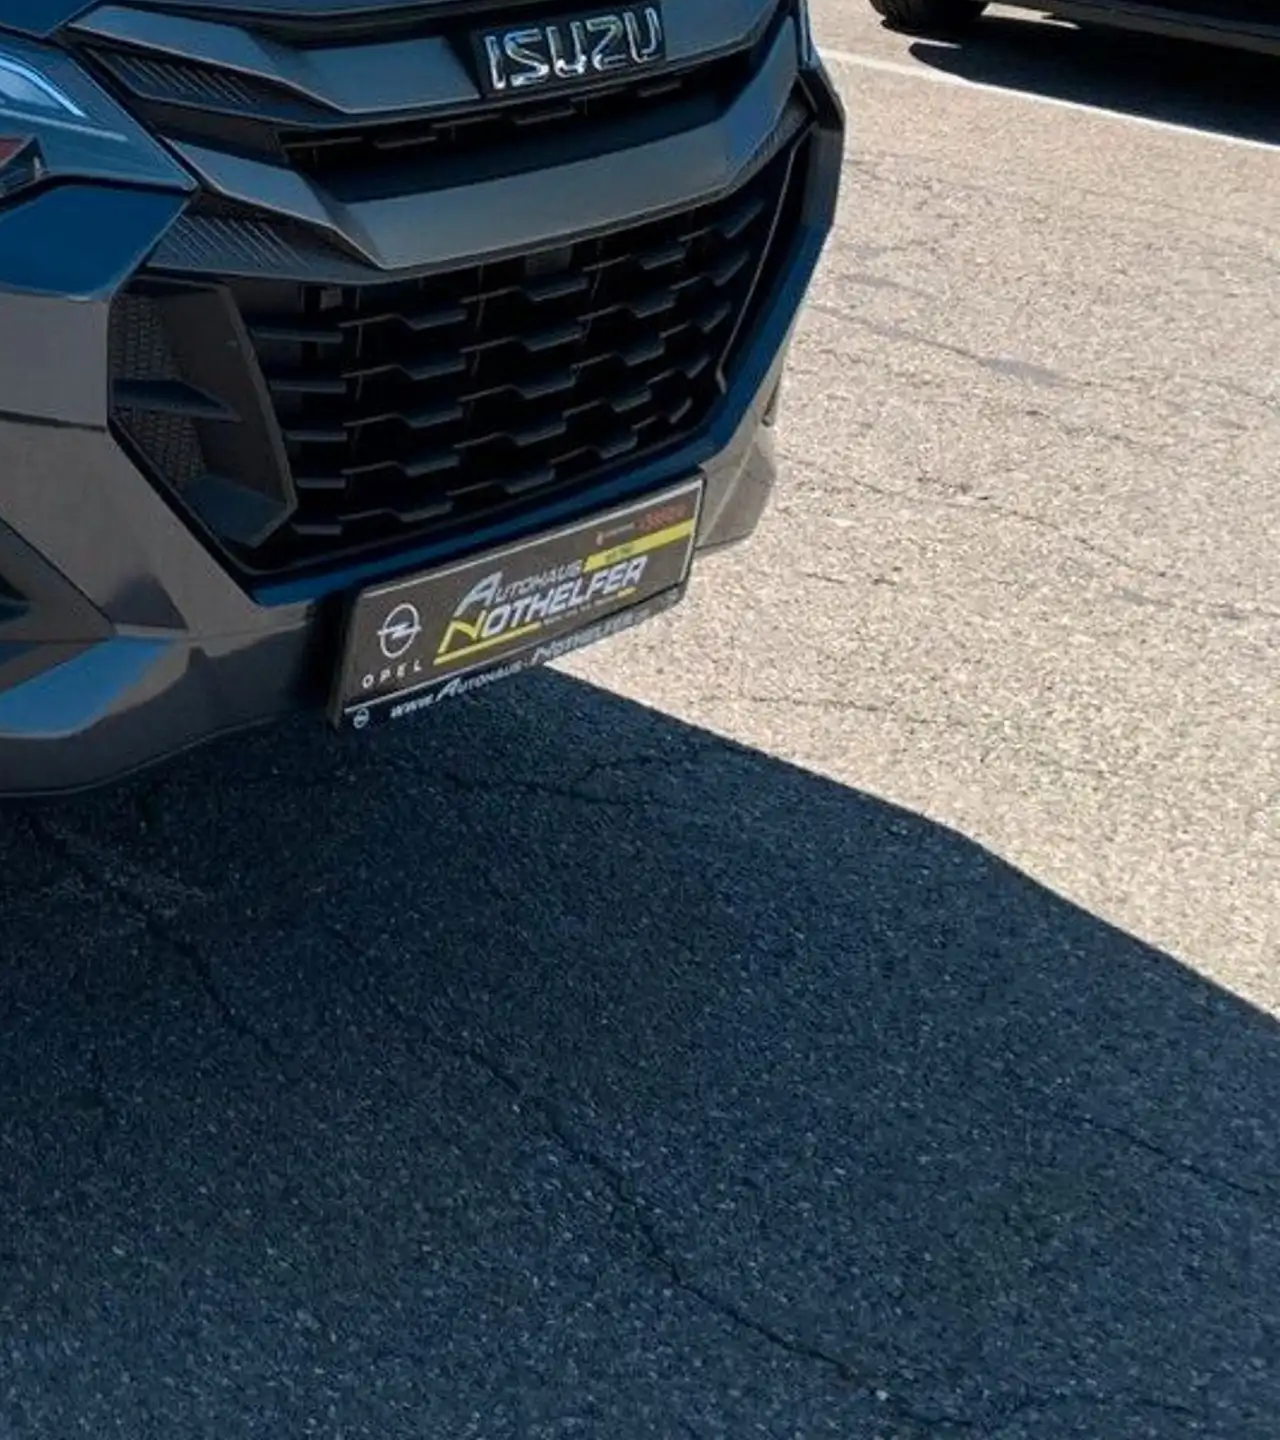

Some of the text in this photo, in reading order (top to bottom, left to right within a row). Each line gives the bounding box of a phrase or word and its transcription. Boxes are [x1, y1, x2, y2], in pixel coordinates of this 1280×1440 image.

[483, 6, 662, 90] ISUZU
[437, 555, 648, 654] NOTHELFER
[453, 558, 582, 618] AUTOHAUS
[362, 660, 423, 689] OPEL
